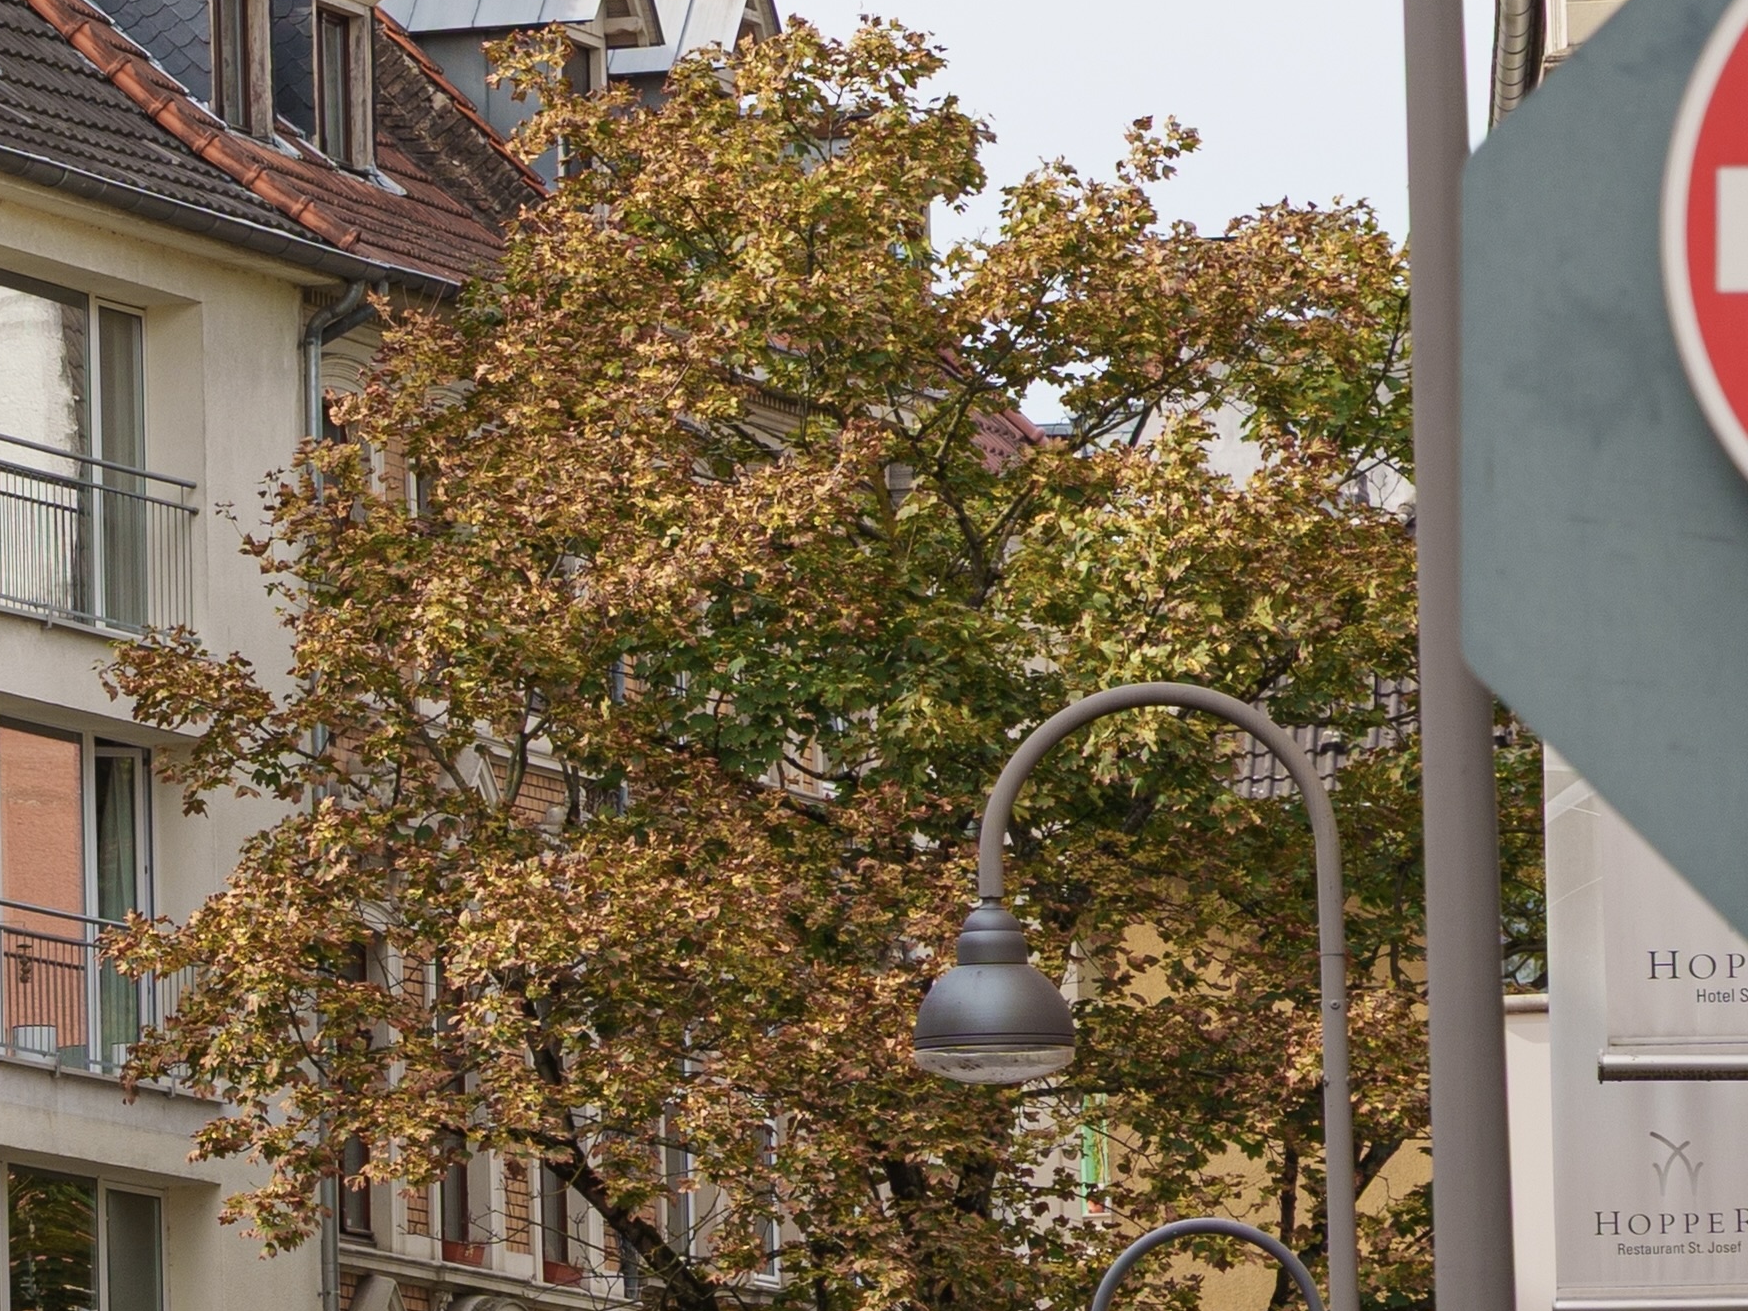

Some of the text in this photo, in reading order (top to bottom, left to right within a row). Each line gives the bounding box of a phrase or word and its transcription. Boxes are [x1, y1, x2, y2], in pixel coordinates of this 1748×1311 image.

[1646, 950, 1746, 980] HOP
[1696, 988, 1735, 1003] Hotel
[1617, 1241, 1742, 1256] Restaurant St. Josef
